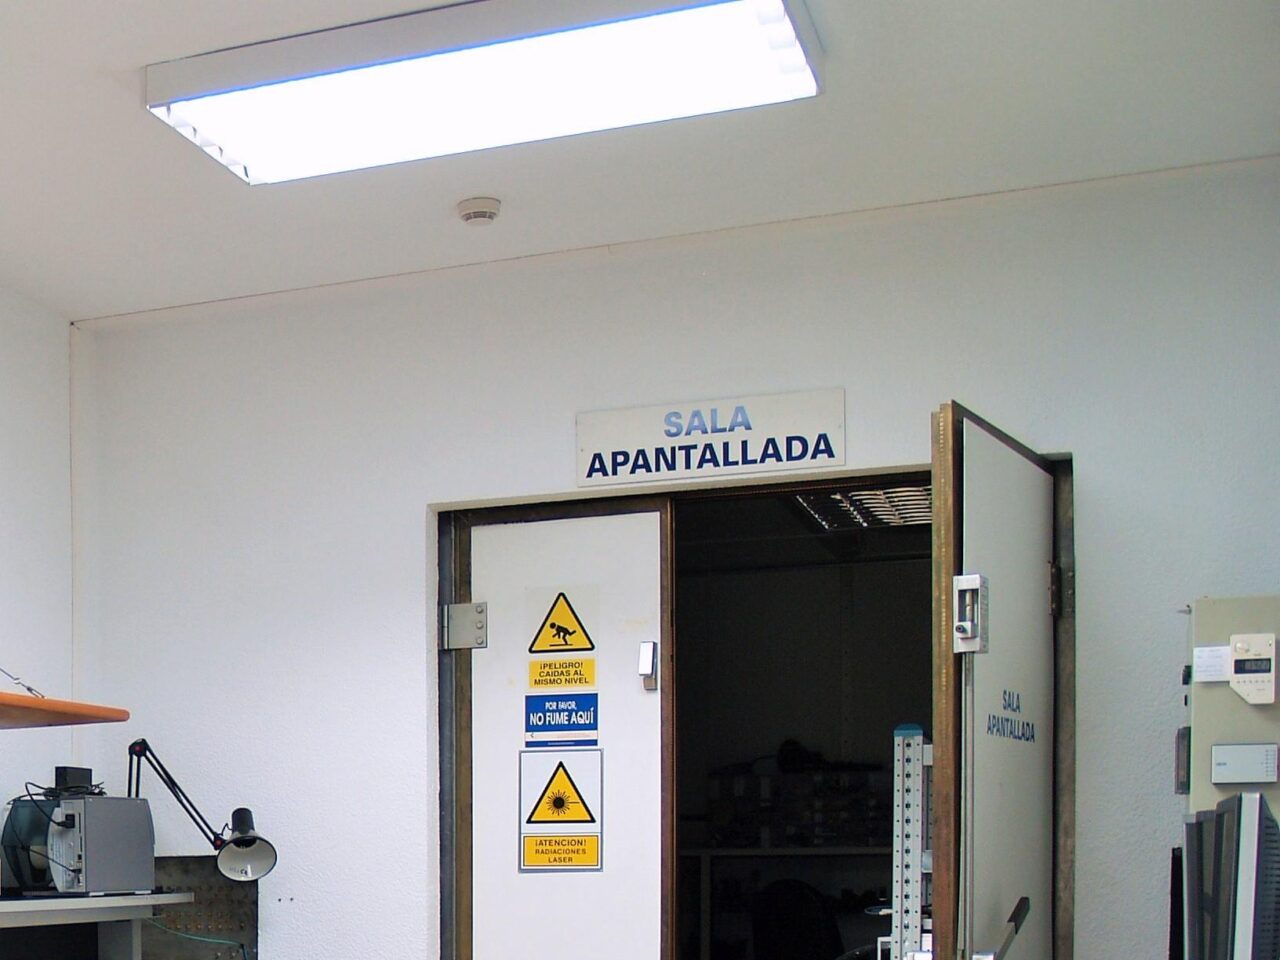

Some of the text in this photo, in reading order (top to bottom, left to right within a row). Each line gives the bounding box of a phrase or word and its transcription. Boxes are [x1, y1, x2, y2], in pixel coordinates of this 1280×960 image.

[663, 405, 752, 438] SALA
[585, 432, 836, 479] APANTALLADA
[573, 669, 585, 677] AL
[533, 676, 589, 686] MISMO NIVEL
[545, 701, 557, 710] POR
[1002, 688, 1021, 713] SALA
[529, 706, 595, 726] NO FUME AQUÍ
[986, 713, 1036, 744] APANTALLADA
[534, 848, 587, 856] RADIACIONES
[547, 856, 573, 864] LASER
